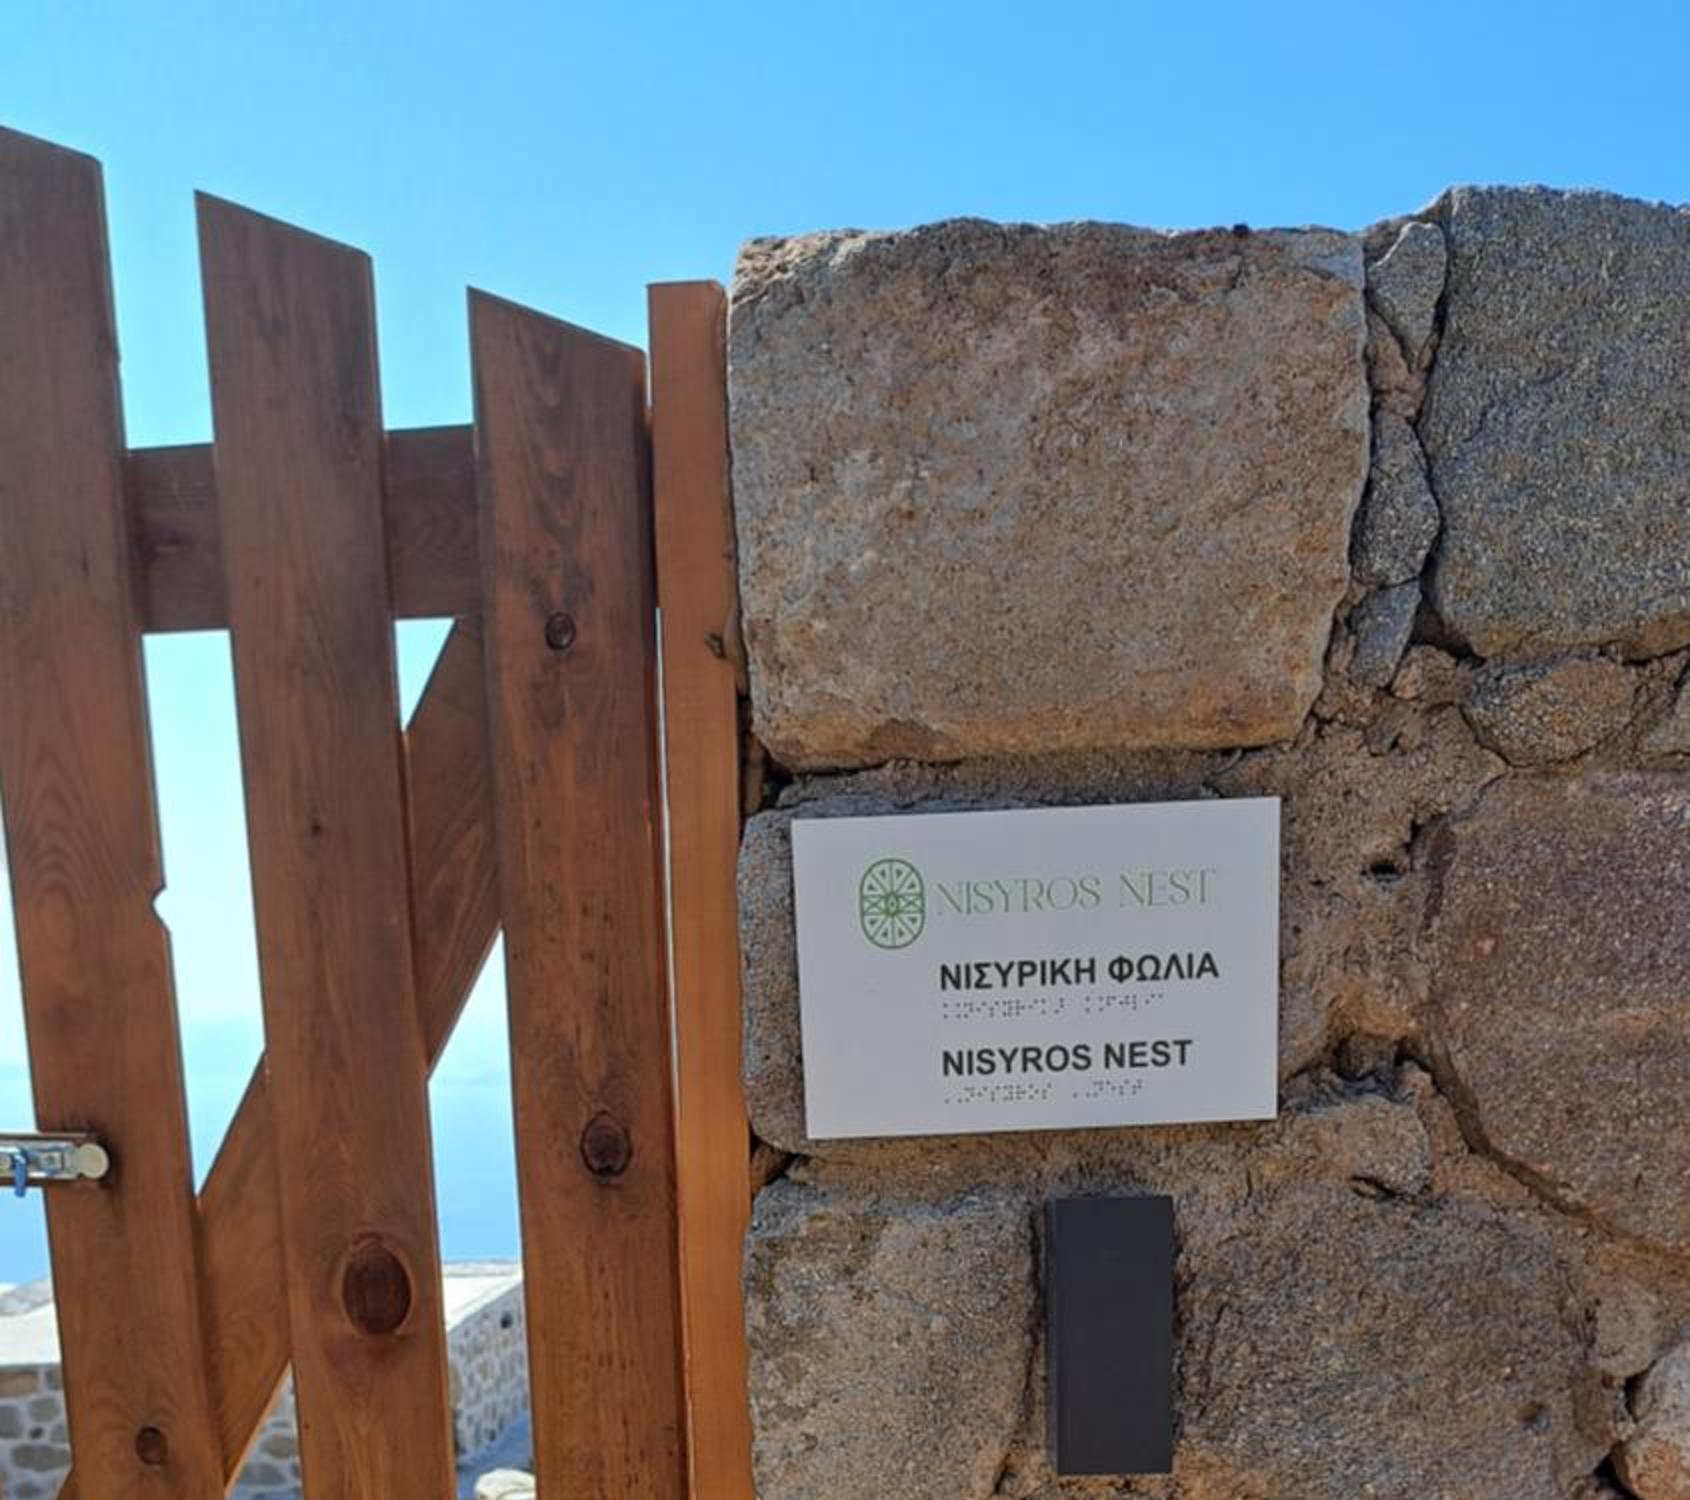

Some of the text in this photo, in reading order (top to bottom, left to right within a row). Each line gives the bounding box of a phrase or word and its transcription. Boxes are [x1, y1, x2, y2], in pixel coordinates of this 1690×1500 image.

[936, 868, 1218, 917] NISYROS NEST
[939, 952, 1220, 991] ΝΙΣΥΡΙΚΗ ΦΩΛΙΑ
[942, 1039, 1194, 1077] NISYROS NEST
